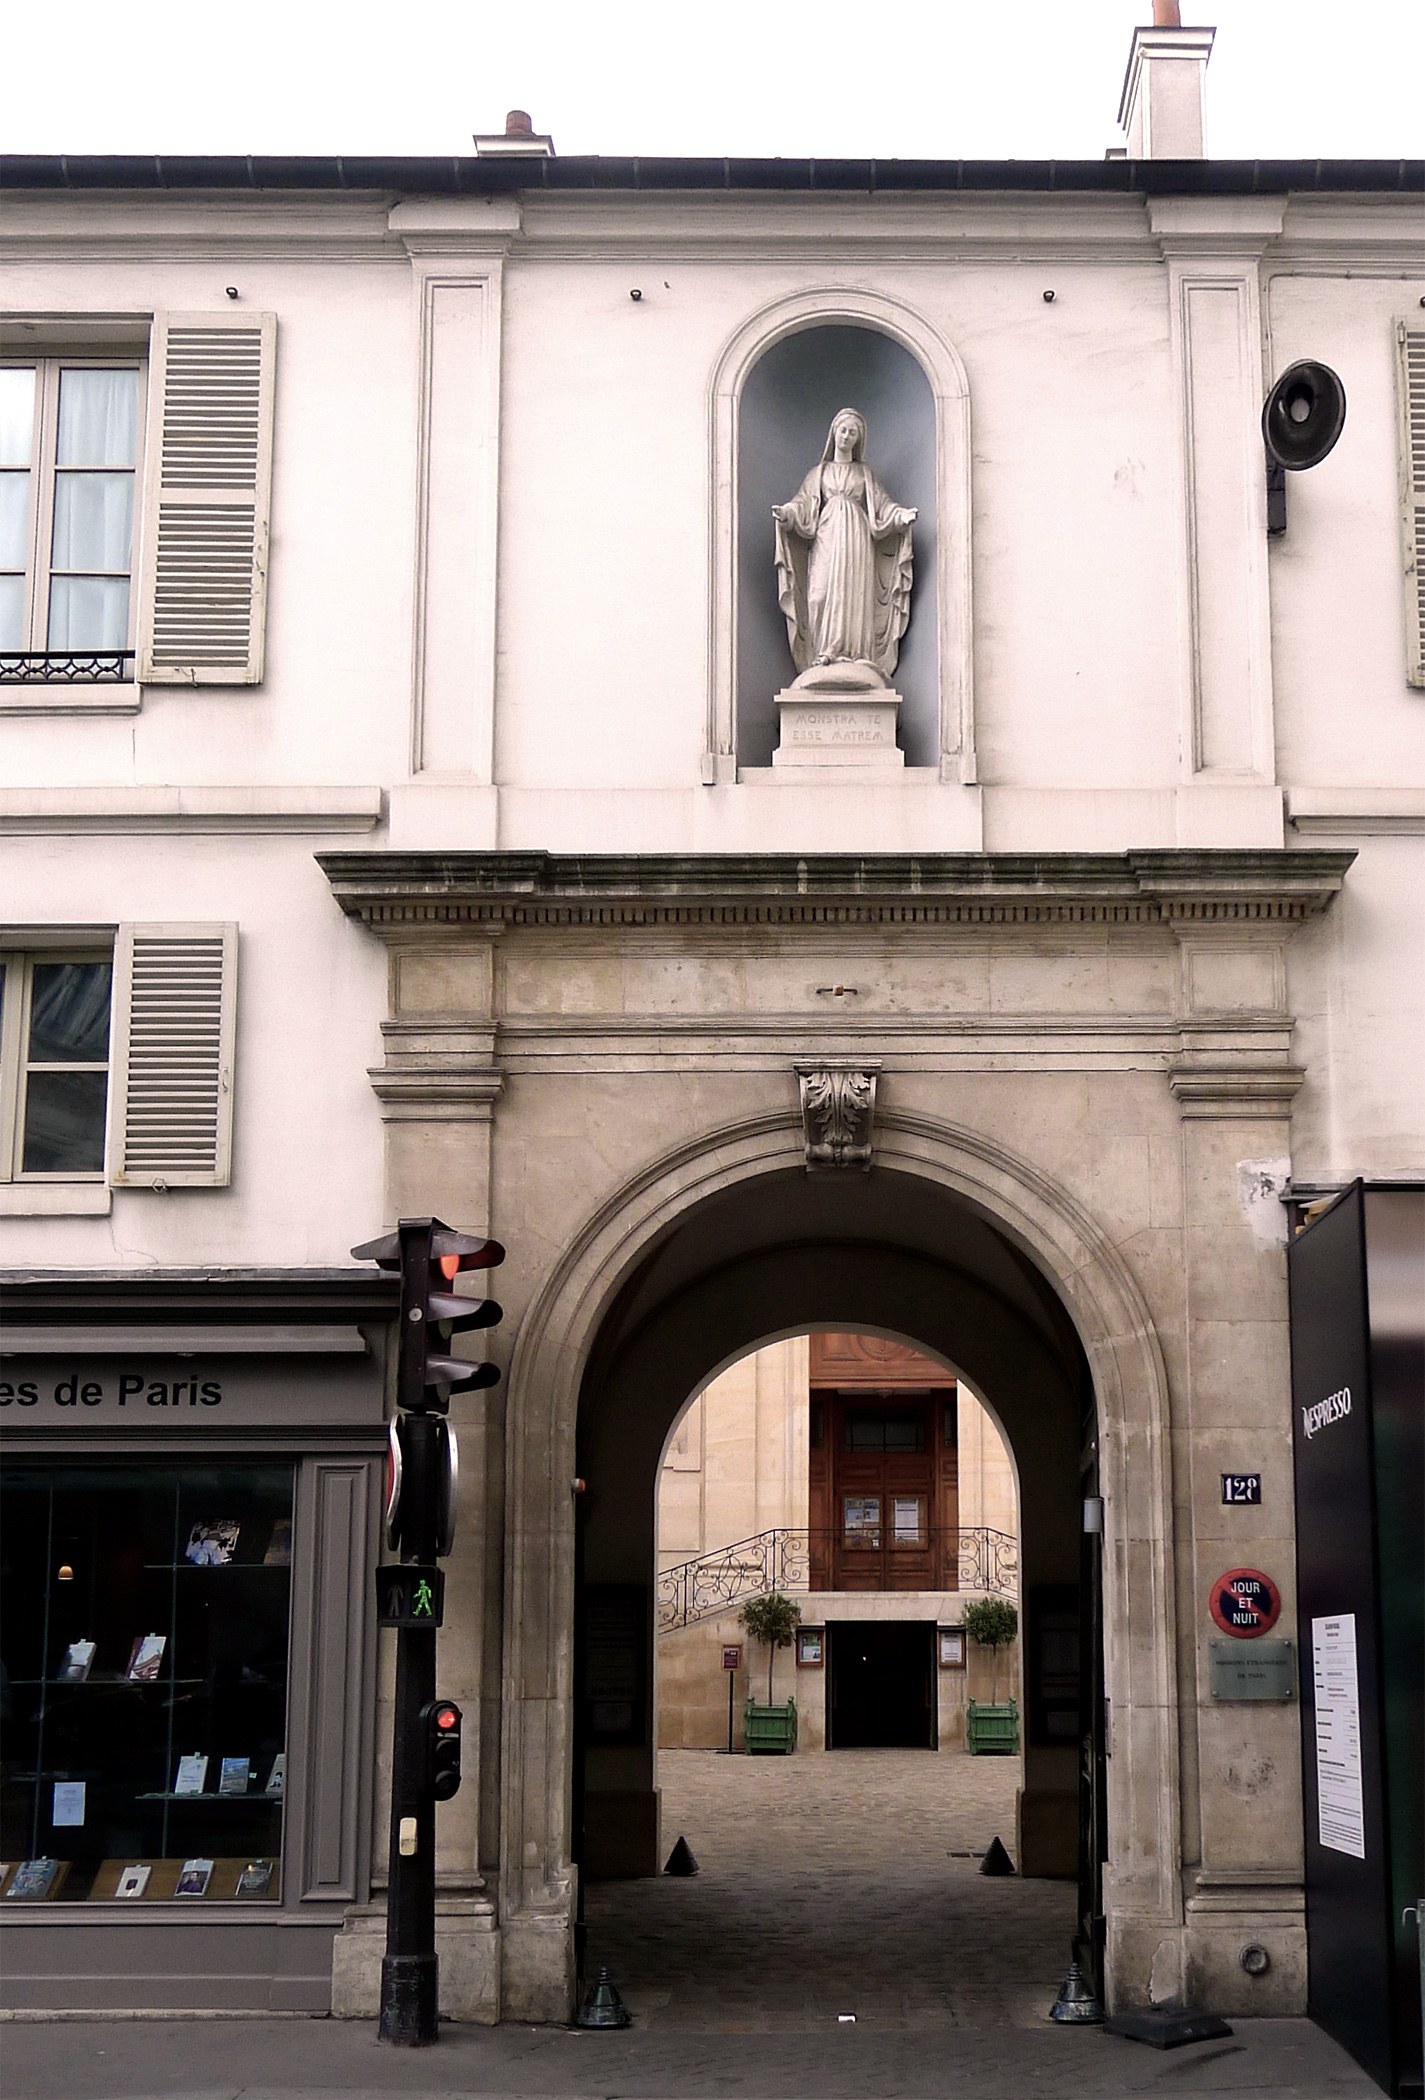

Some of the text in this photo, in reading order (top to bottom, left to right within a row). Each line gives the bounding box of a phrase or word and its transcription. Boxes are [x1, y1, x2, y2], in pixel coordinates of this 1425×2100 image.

[797, 714, 881, 724] MONSTRA TE
[792, 730, 883, 740] ESSE MATREM
[54, 1375, 103, 1406] de
[118, 1375, 222, 1406] Paris
[1301, 1387, 1351, 1439] NESPRESSO
[1225, 1477, 1257, 1500] 128
[1231, 1582, 1260, 1593] JOUR
[1239, 1597, 1253, 1608] ET
[1233, 1613, 1259, 1624] NUIT
